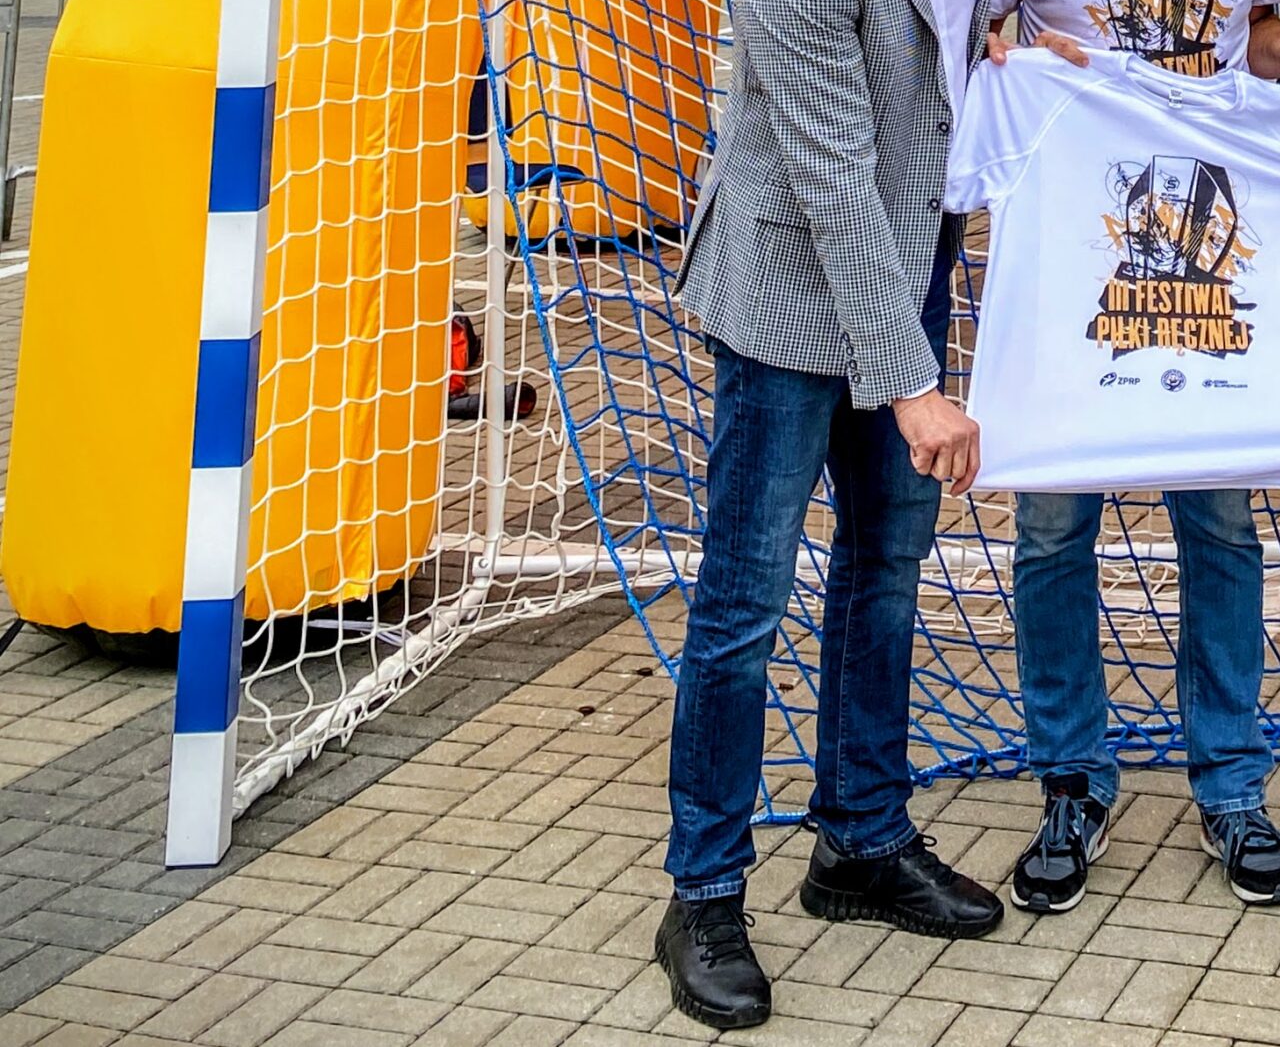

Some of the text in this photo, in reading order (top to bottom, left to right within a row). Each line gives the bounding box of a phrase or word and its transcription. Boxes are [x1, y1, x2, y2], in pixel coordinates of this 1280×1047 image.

[1135, 280, 1234, 315] FESTIWAL
[1097, 316, 1150, 350] PIŁKI
[1117, 376, 1141, 385] ZPRP
